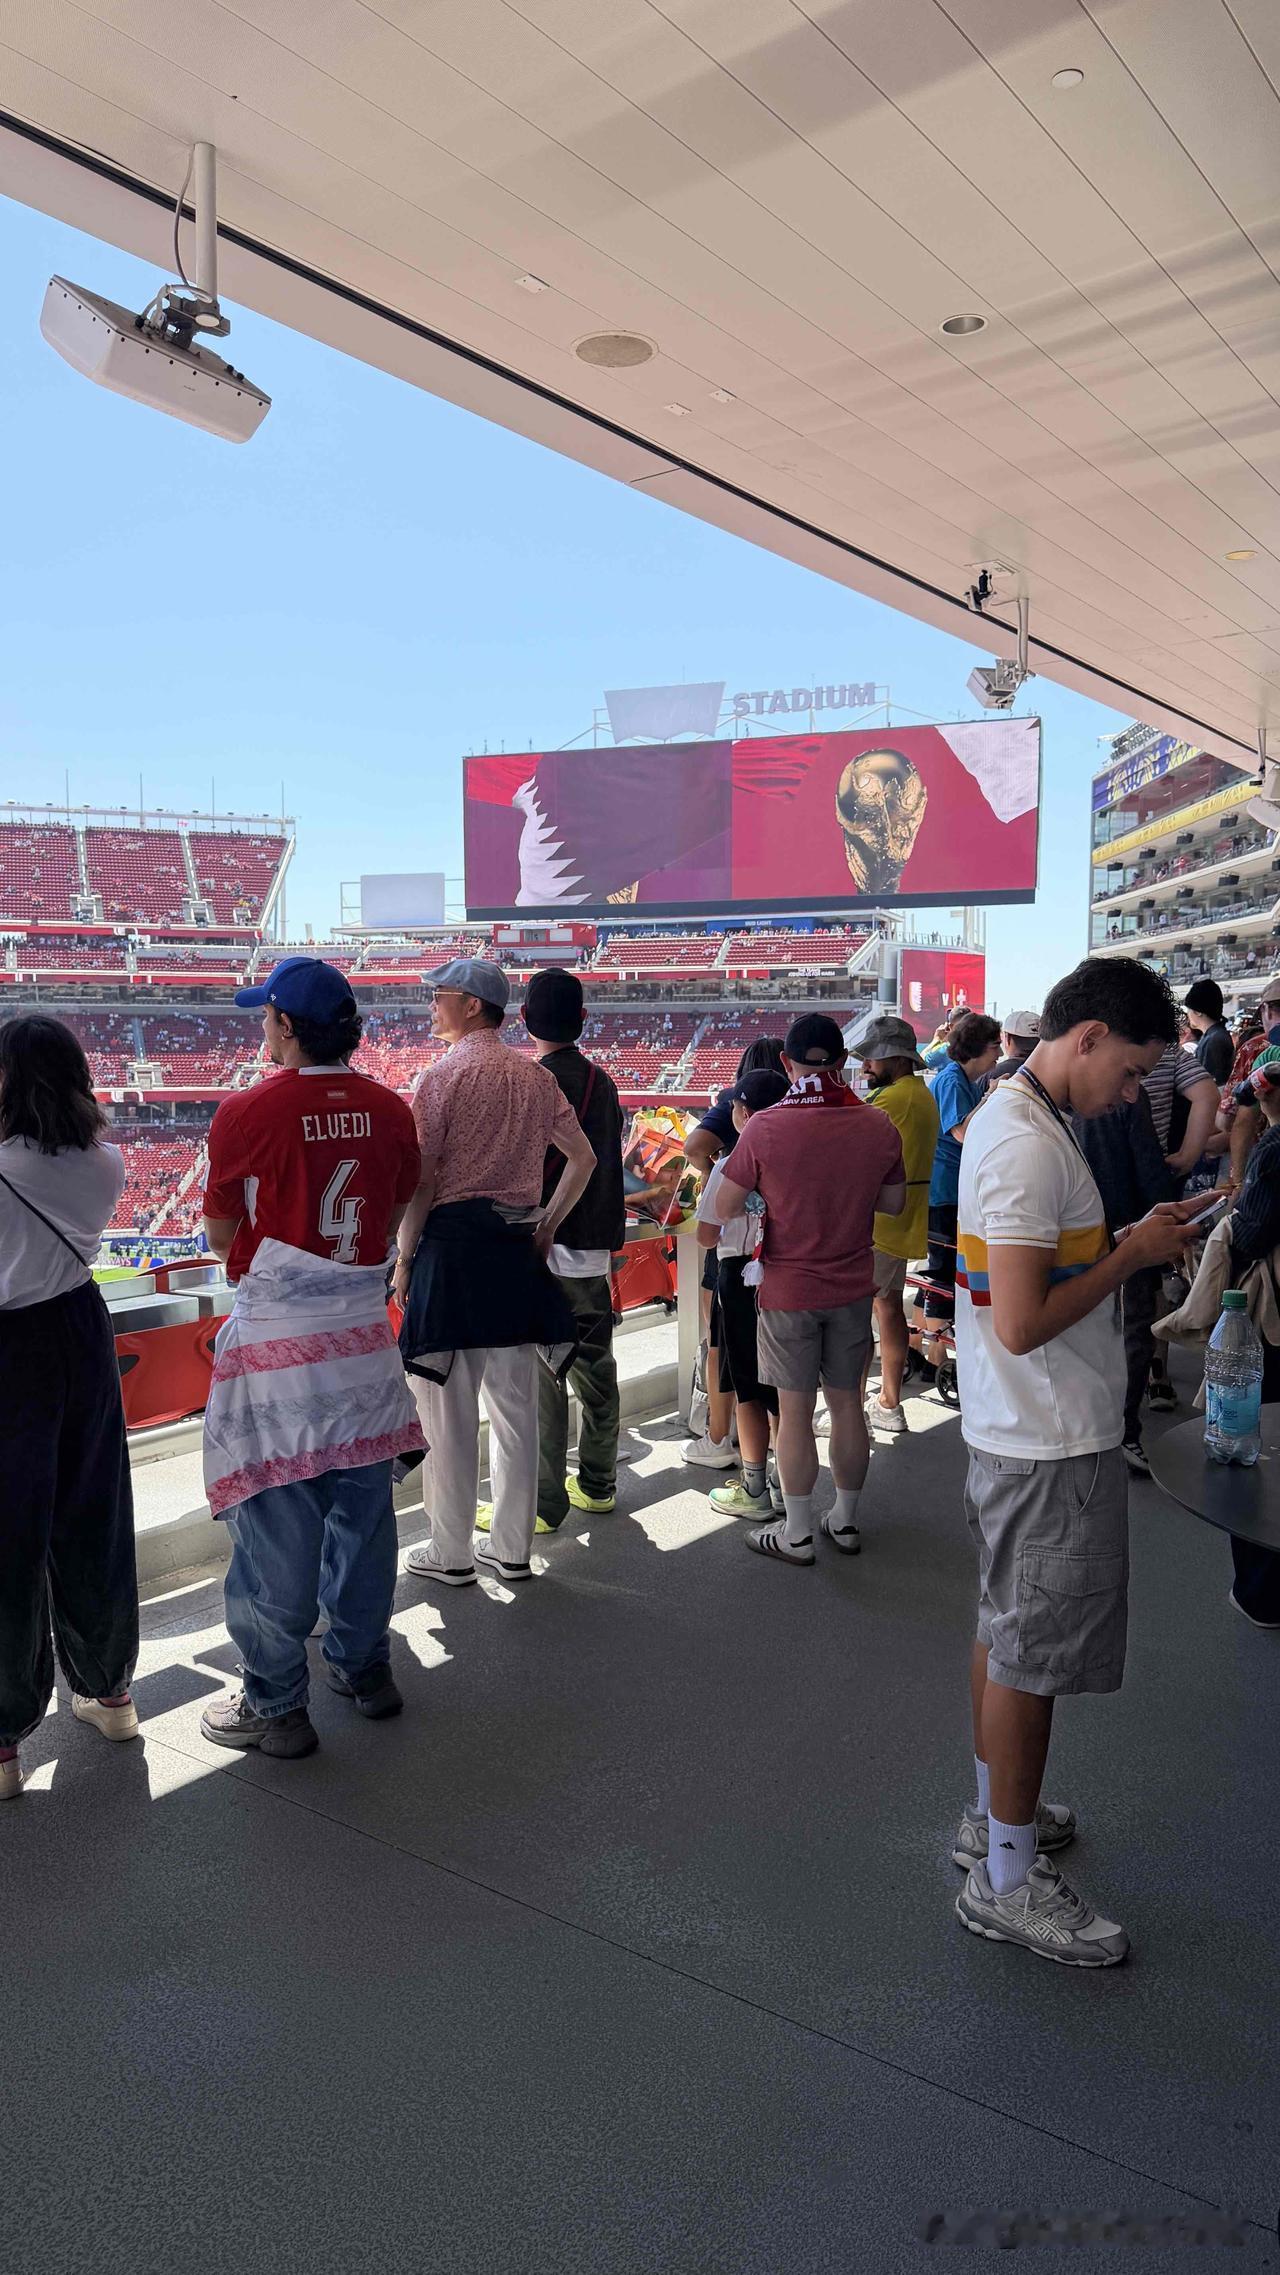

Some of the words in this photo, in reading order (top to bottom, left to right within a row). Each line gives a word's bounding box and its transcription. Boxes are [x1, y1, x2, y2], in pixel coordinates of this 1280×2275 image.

[733, 682, 876, 717] STADIUM
[801, 1095, 825, 1104] AREA
[318, 1159, 366, 1265] 4
